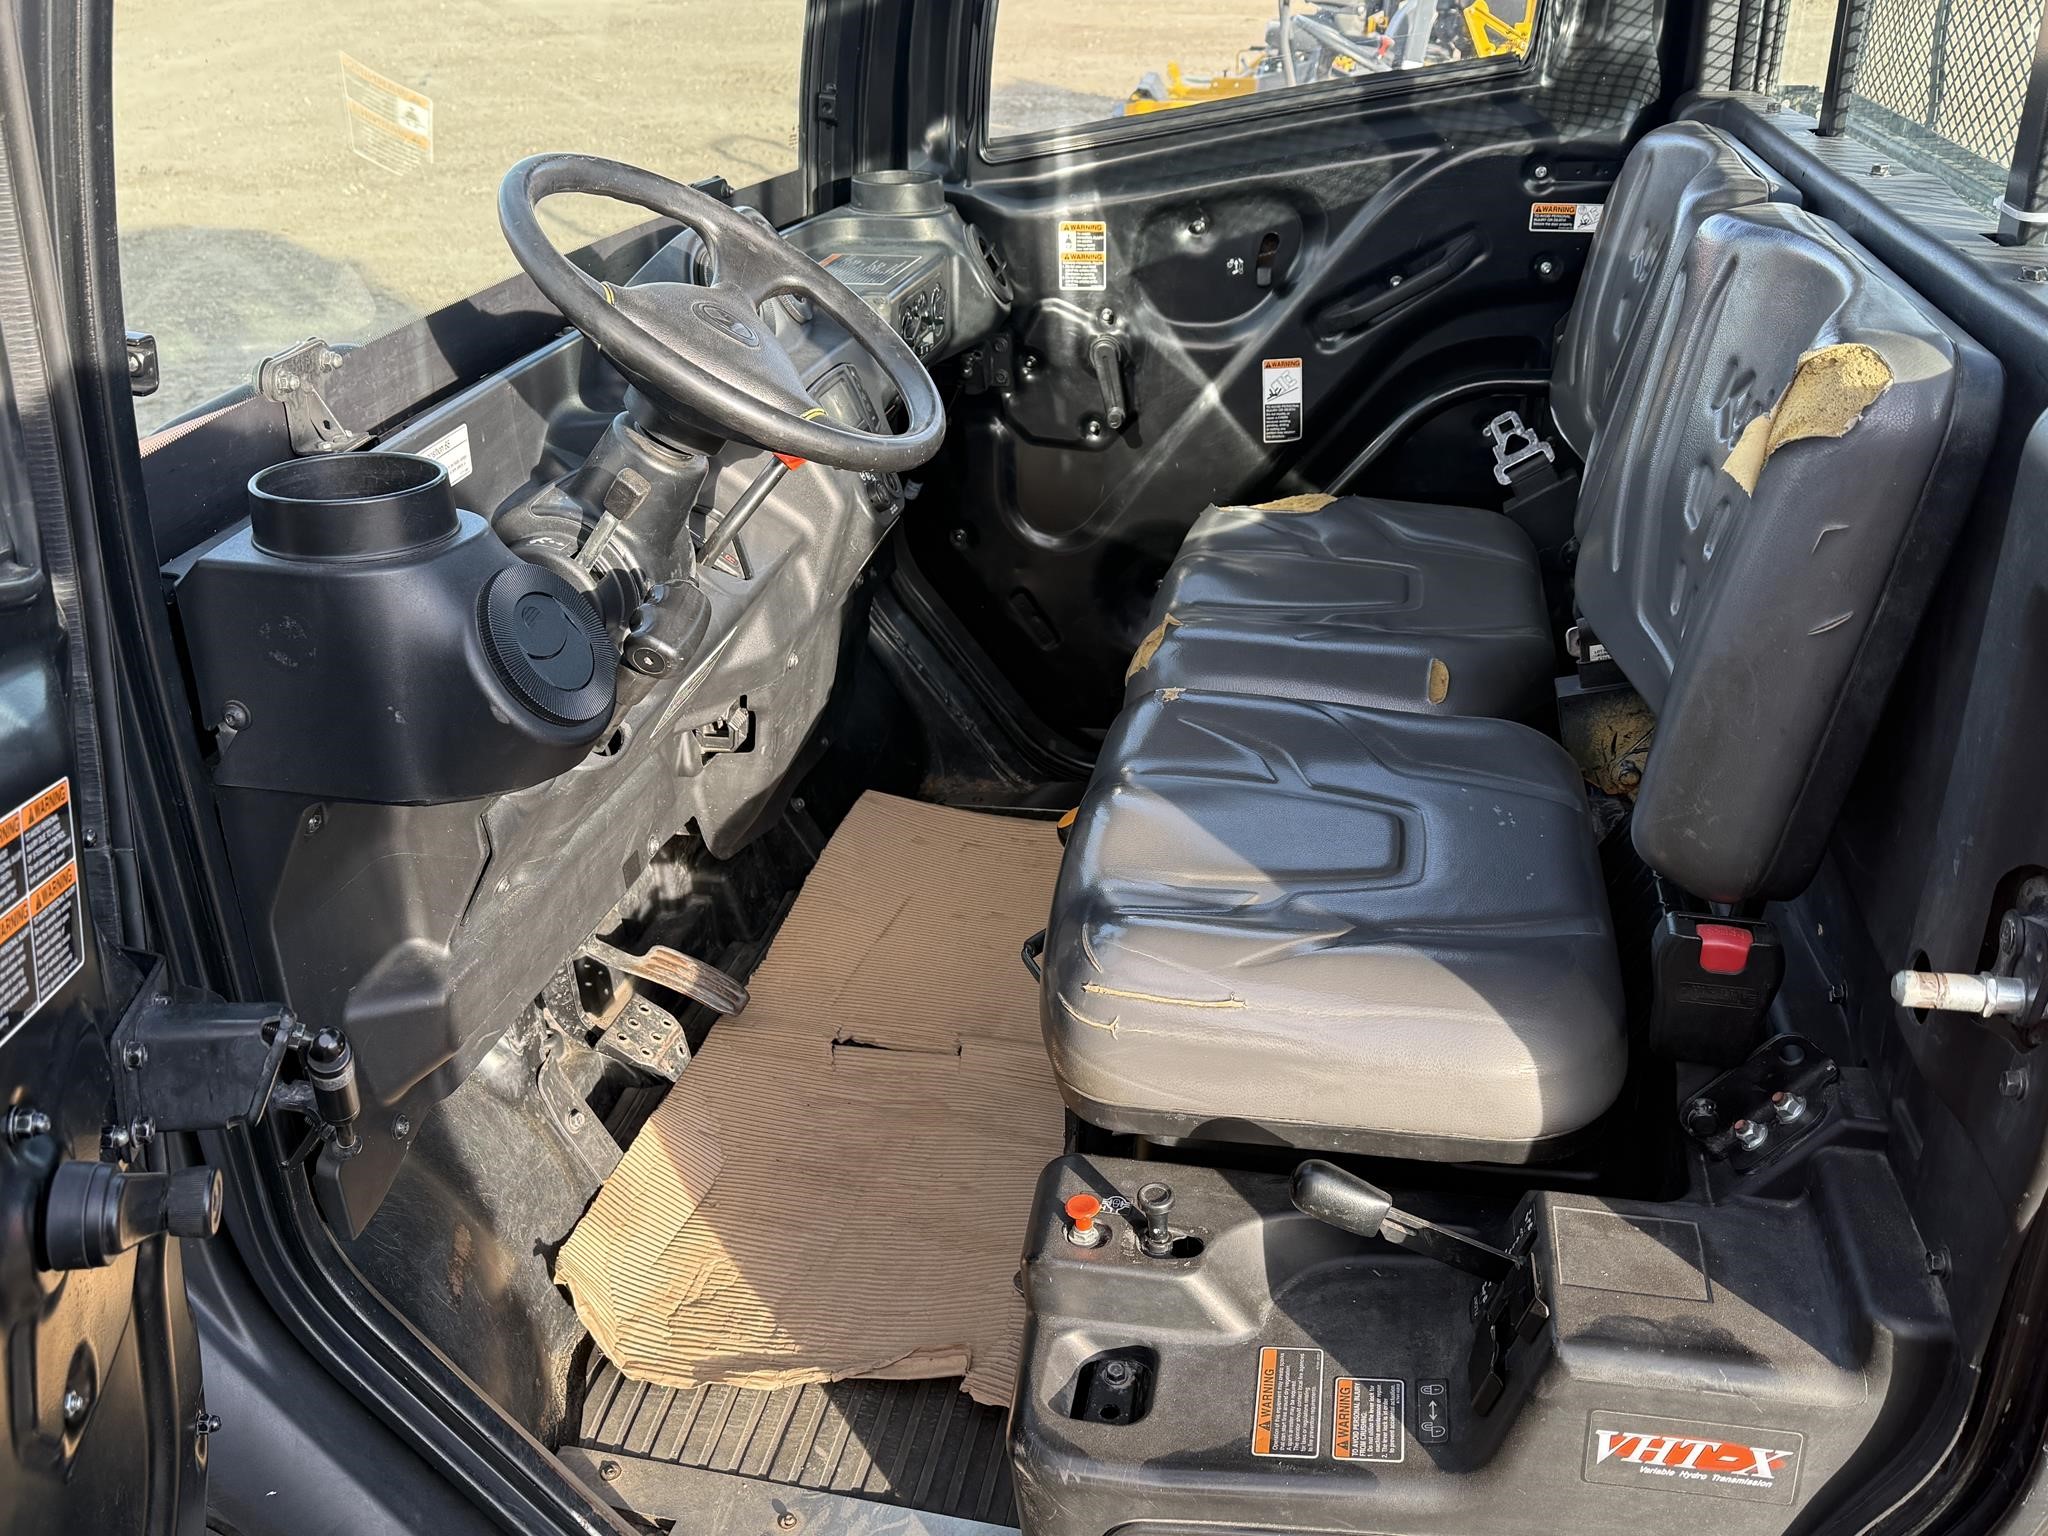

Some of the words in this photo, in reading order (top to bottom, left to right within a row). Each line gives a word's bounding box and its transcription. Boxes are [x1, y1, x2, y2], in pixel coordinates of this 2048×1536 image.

[1271, 360, 1300, 368] WARNING
[34, 786, 67, 818] WARNING
[41, 867, 73, 905] WARNING
[1261, 1369, 1274, 1417] WARNING
[1338, 1388, 1350, 1437] WARNING
[1639, 1465, 1676, 1478] Variable
[1679, 1469, 1708, 1481] Hydro
[1711, 1473, 1774, 1489] Transmission
